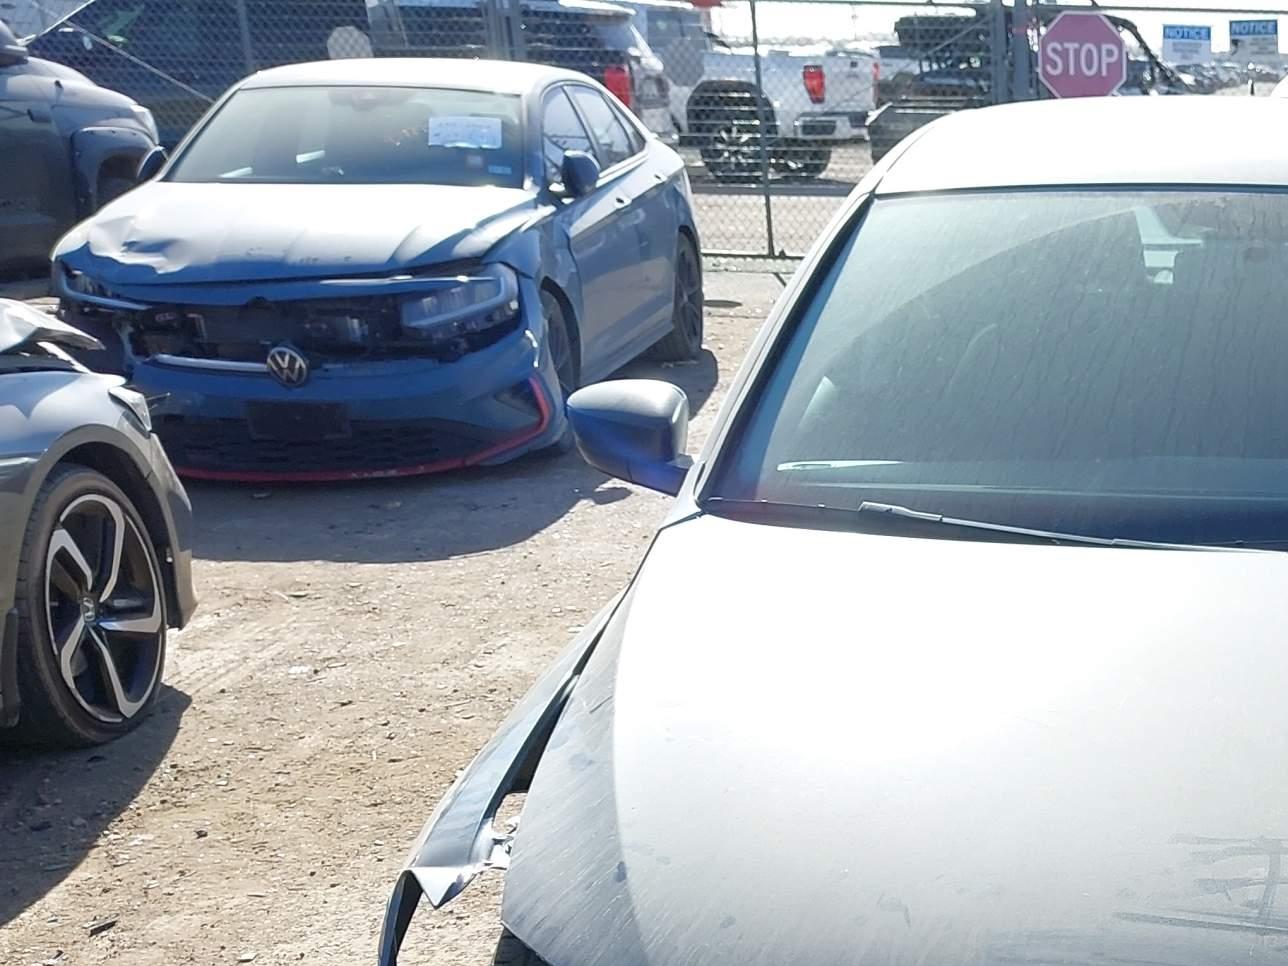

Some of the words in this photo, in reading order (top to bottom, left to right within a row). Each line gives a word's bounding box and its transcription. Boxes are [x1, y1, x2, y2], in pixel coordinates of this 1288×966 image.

[1165, 28, 1208, 38] NOTICE
[1231, 22, 1276, 34] NOTICE
[1045, 42, 1119, 77] STOP
